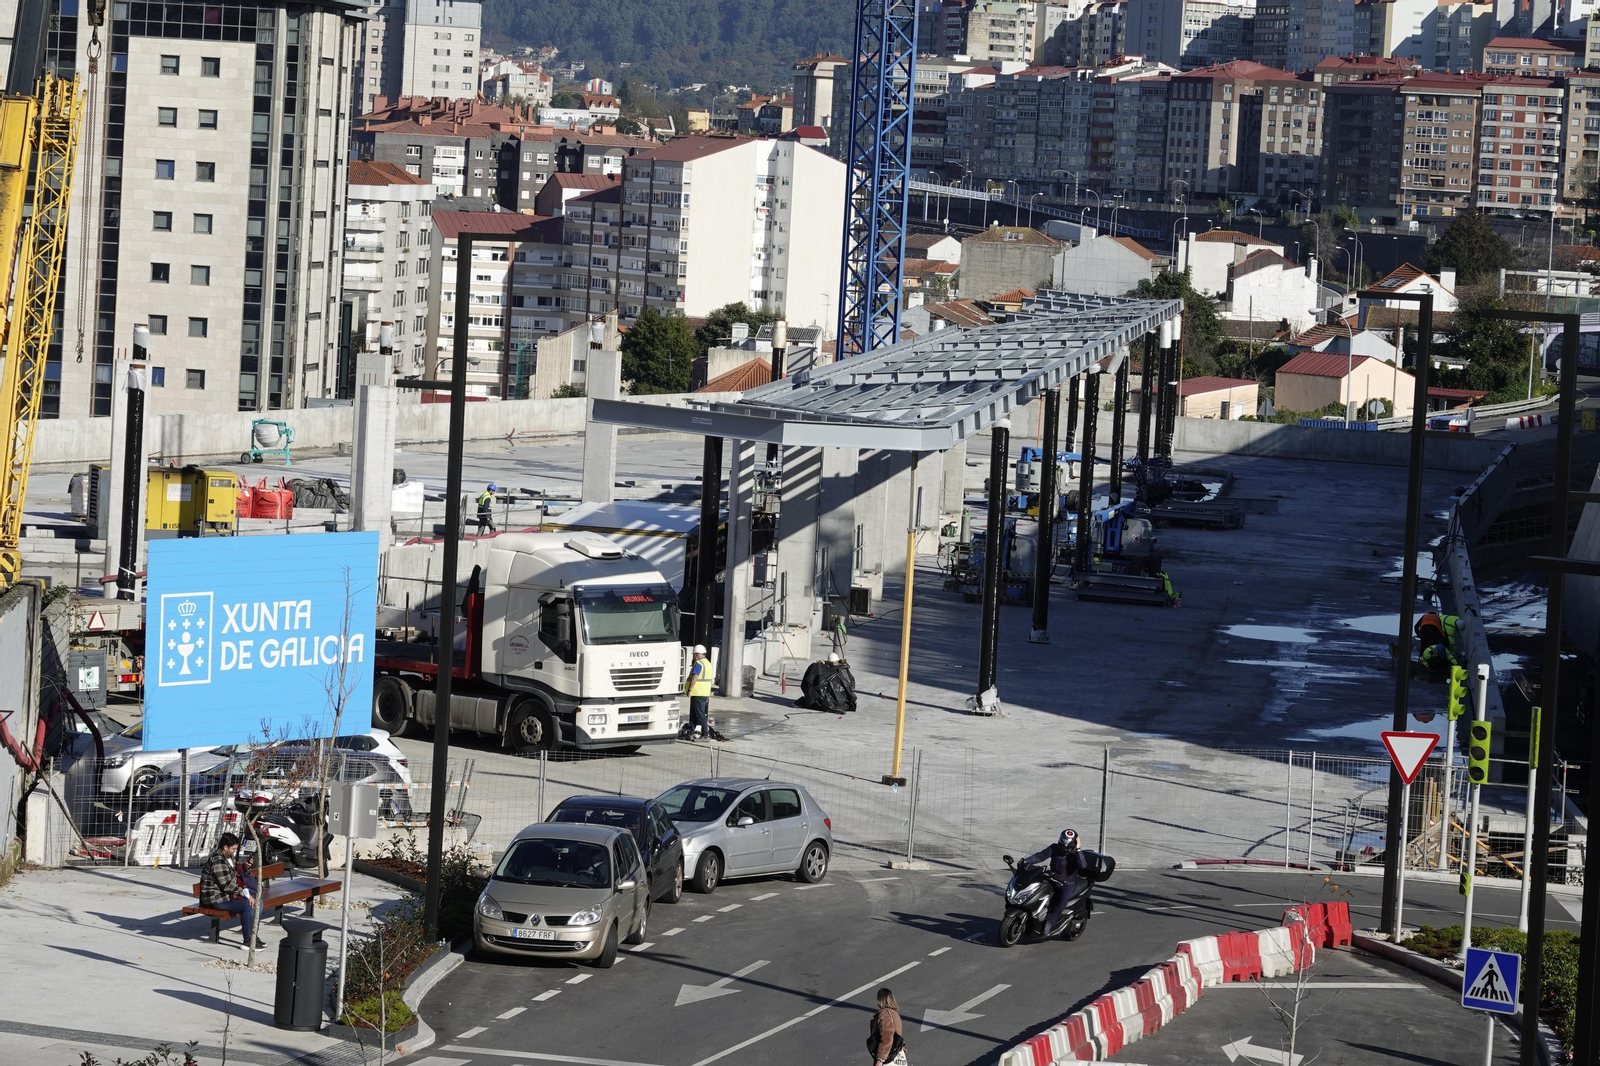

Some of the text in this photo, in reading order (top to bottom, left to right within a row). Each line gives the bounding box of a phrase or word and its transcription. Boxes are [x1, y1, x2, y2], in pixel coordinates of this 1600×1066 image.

[221, 600, 312, 633] XUNTA
[220, 633, 365, 671] DE GALICIA
[610, 660, 667, 668] STRALIS
[518, 930, 537, 938] 8627
